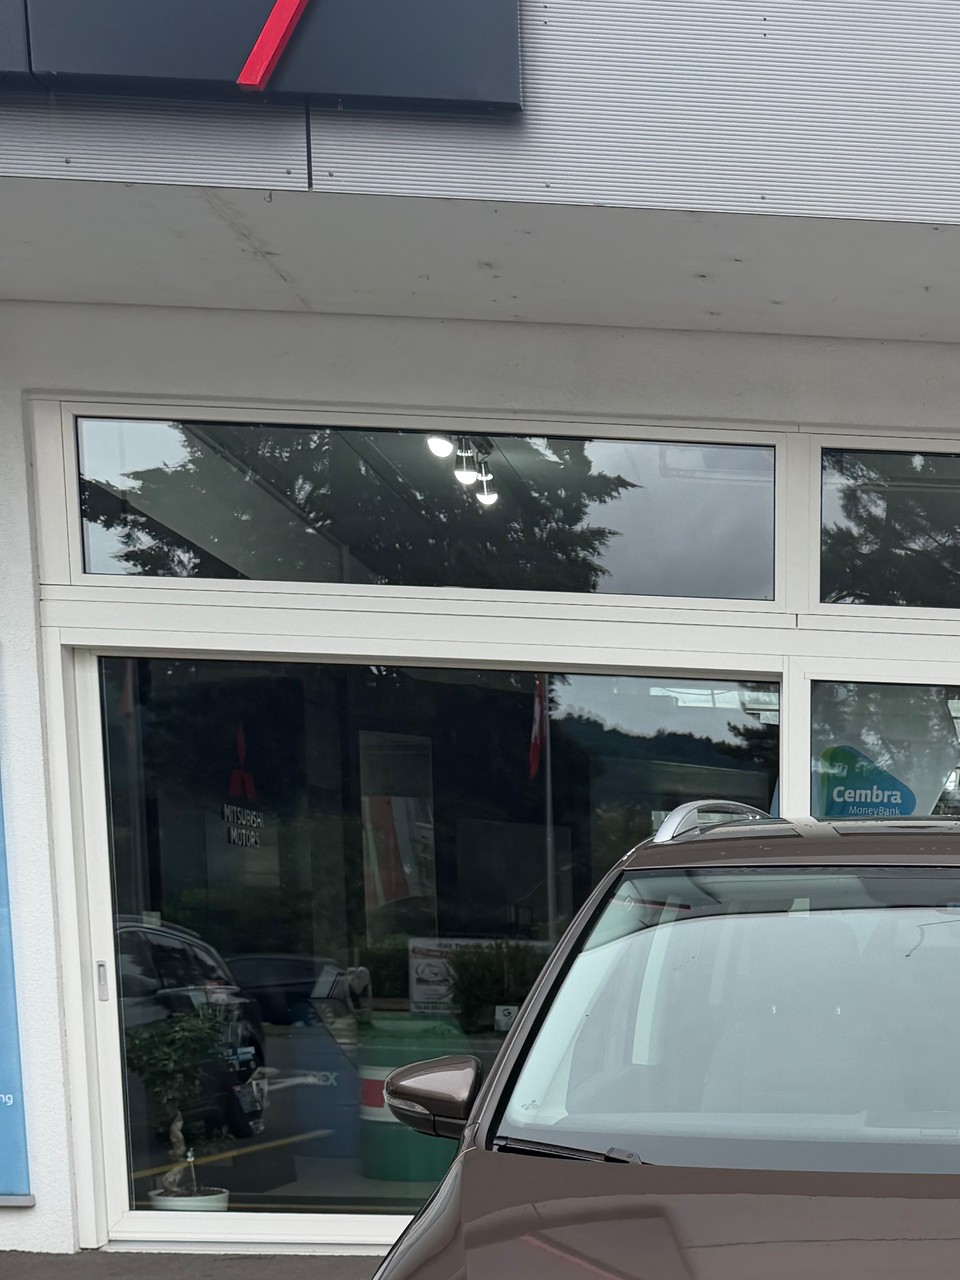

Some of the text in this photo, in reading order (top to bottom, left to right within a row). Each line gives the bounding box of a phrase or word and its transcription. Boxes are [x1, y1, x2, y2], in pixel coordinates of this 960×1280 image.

[832, 785, 902, 803] Cembra
[224, 803, 264, 828] MITSUBISHI
[848, 806, 901, 816] MoneyBank
[230, 826, 261, 848] MOTORS
